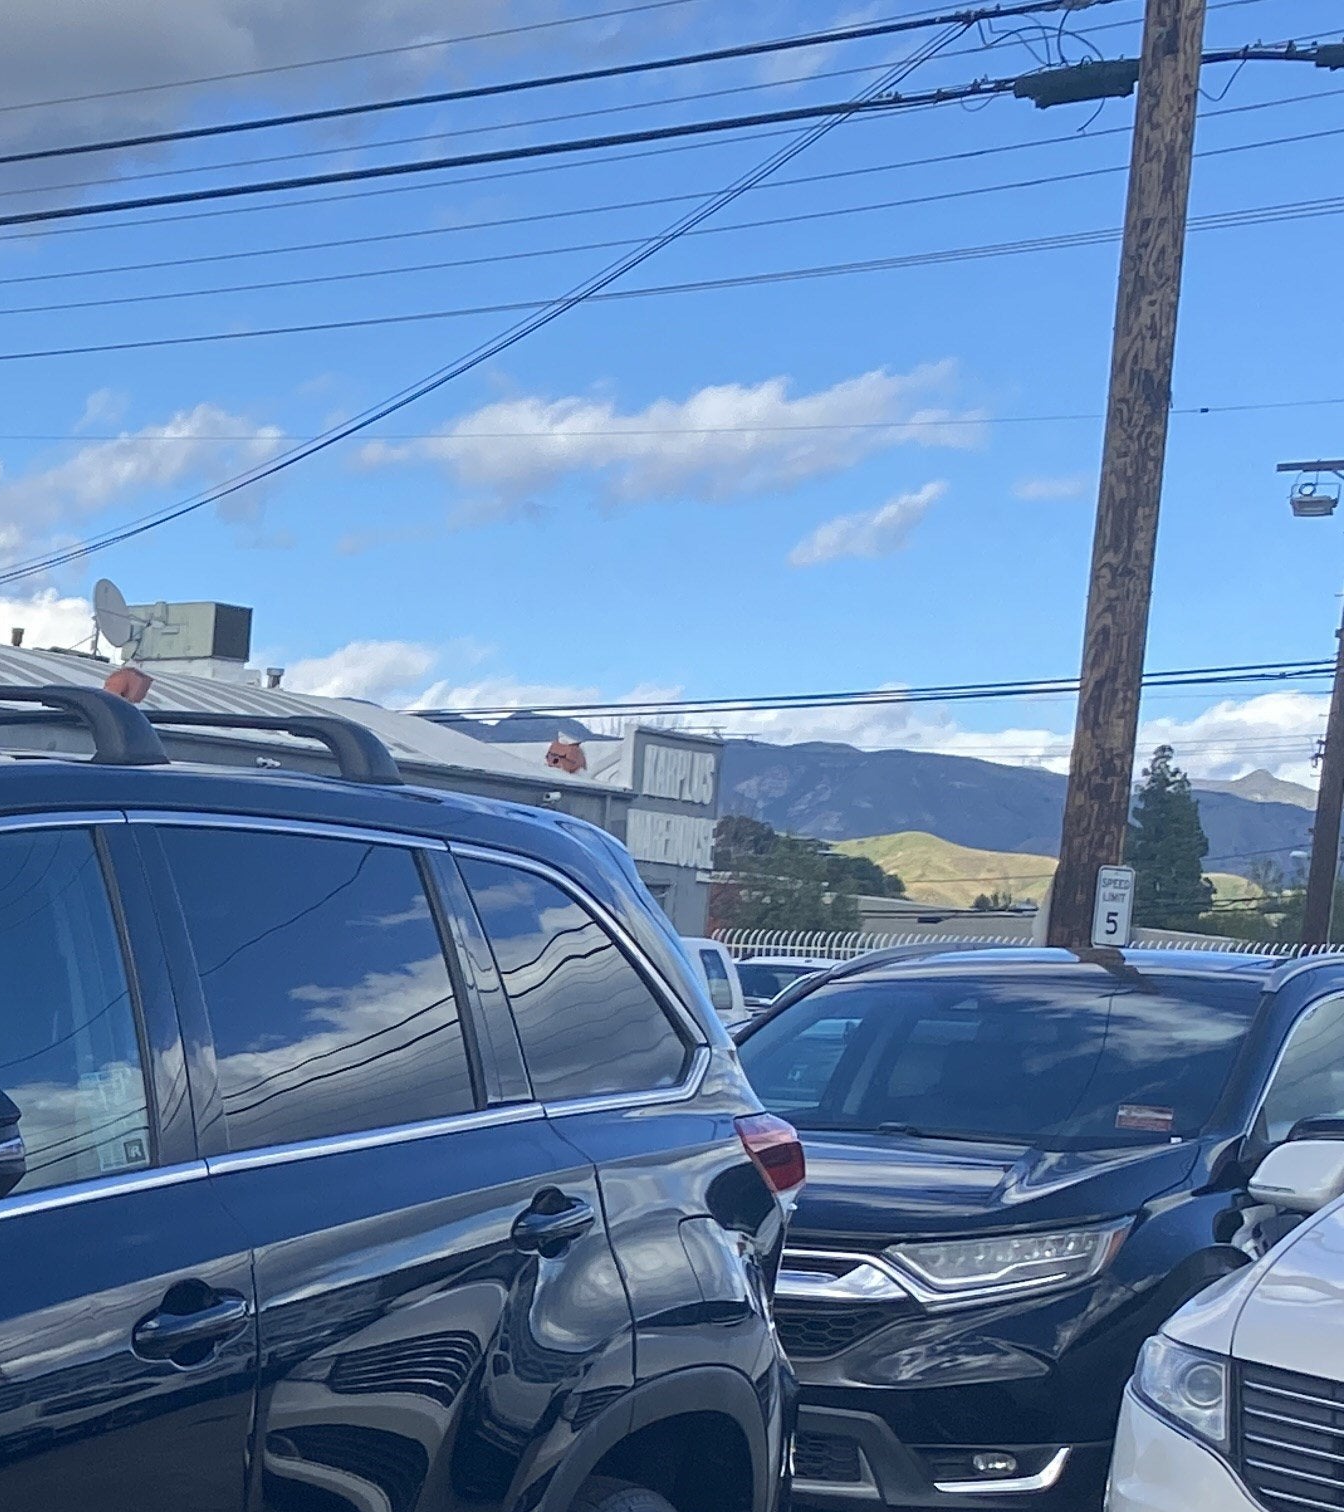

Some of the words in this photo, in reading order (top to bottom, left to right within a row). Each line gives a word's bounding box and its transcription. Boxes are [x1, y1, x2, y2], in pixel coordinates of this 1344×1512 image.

[1102, 878, 1131, 890] SPEED
[1101, 893, 1126, 903] LIMIT
[1105, 911, 1119, 935] 5
